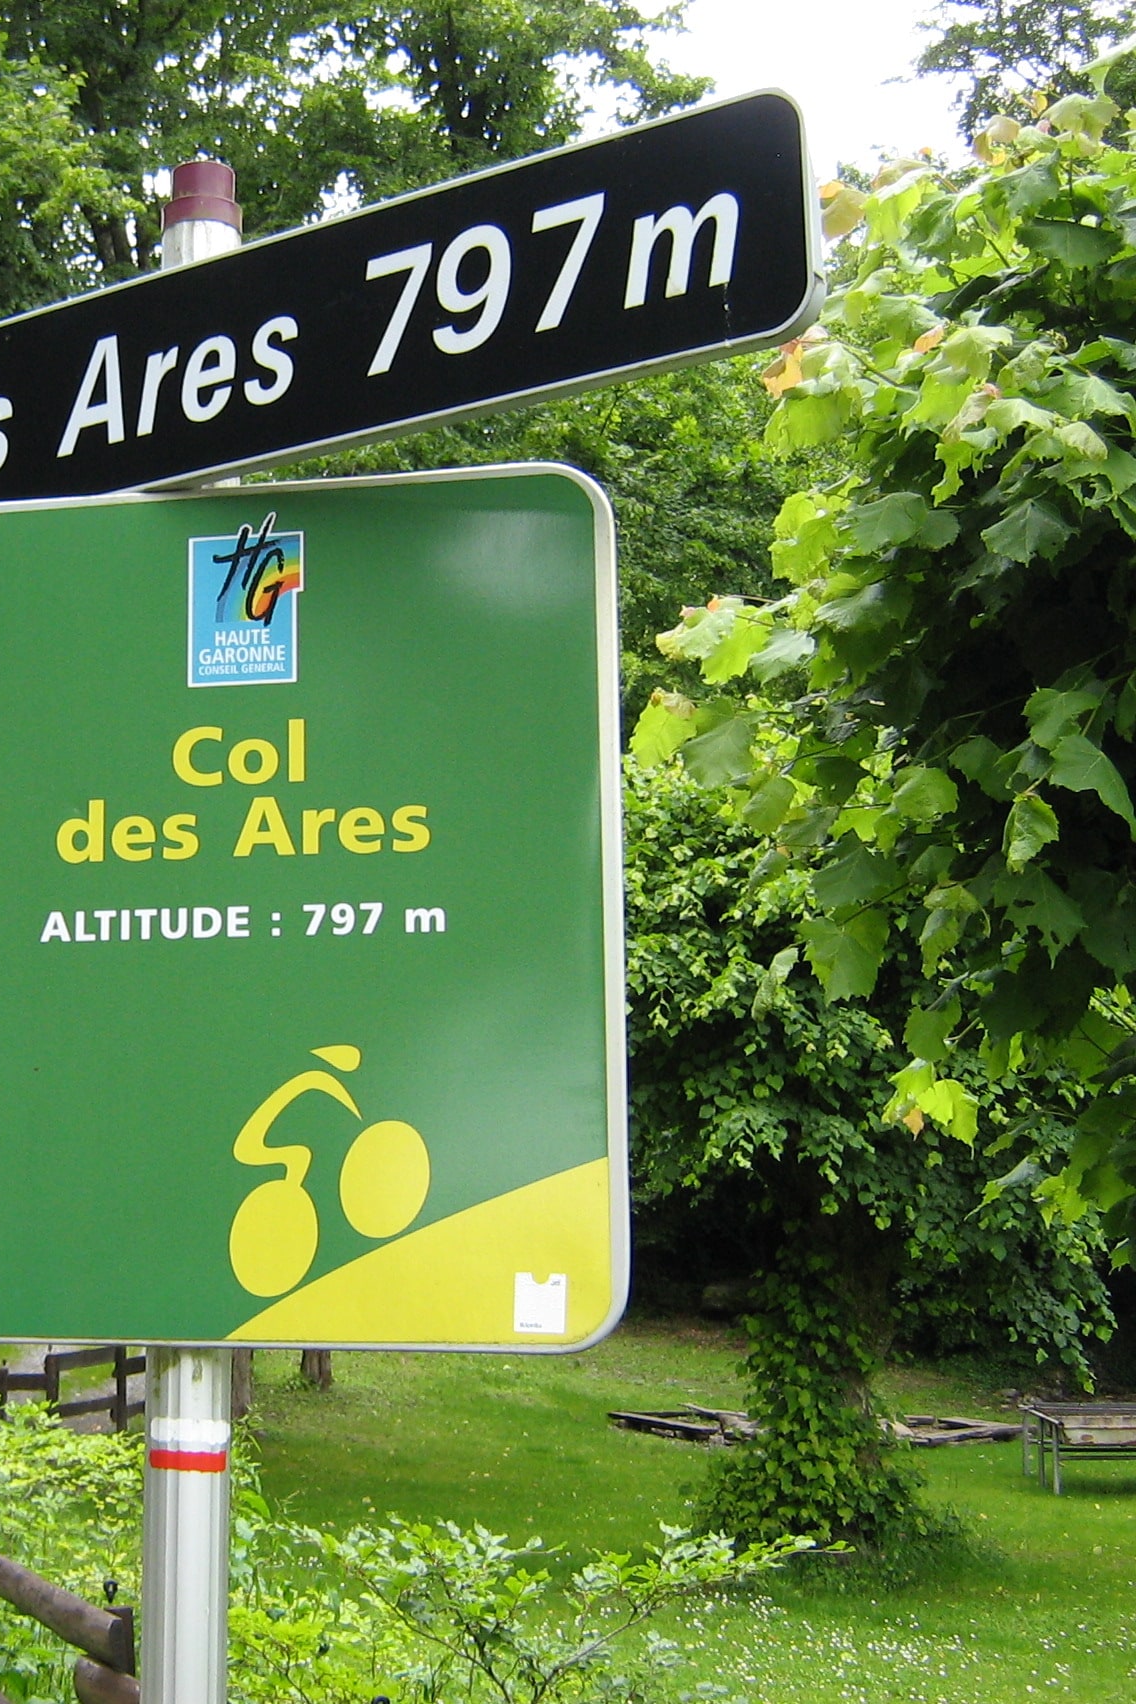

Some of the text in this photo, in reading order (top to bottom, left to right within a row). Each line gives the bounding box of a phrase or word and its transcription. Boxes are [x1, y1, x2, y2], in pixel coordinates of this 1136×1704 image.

[56, 315, 299, 458] Ares
[365, 192, 604, 377] 797
[623, 192, 741, 309] m
[212, 512, 285, 627] HG
[198, 645, 286, 665] GARONNE
[214, 628, 271, 647] HAUTE
[198, 662, 285, 676] CONSEIL GENERAL
[172, 718, 305, 787] Col
[55, 796, 432, 864] des Ares
[40, 905, 251, 943] ALTITUDE
[303, 902, 384, 936] 797
[404, 906, 447, 934] m
